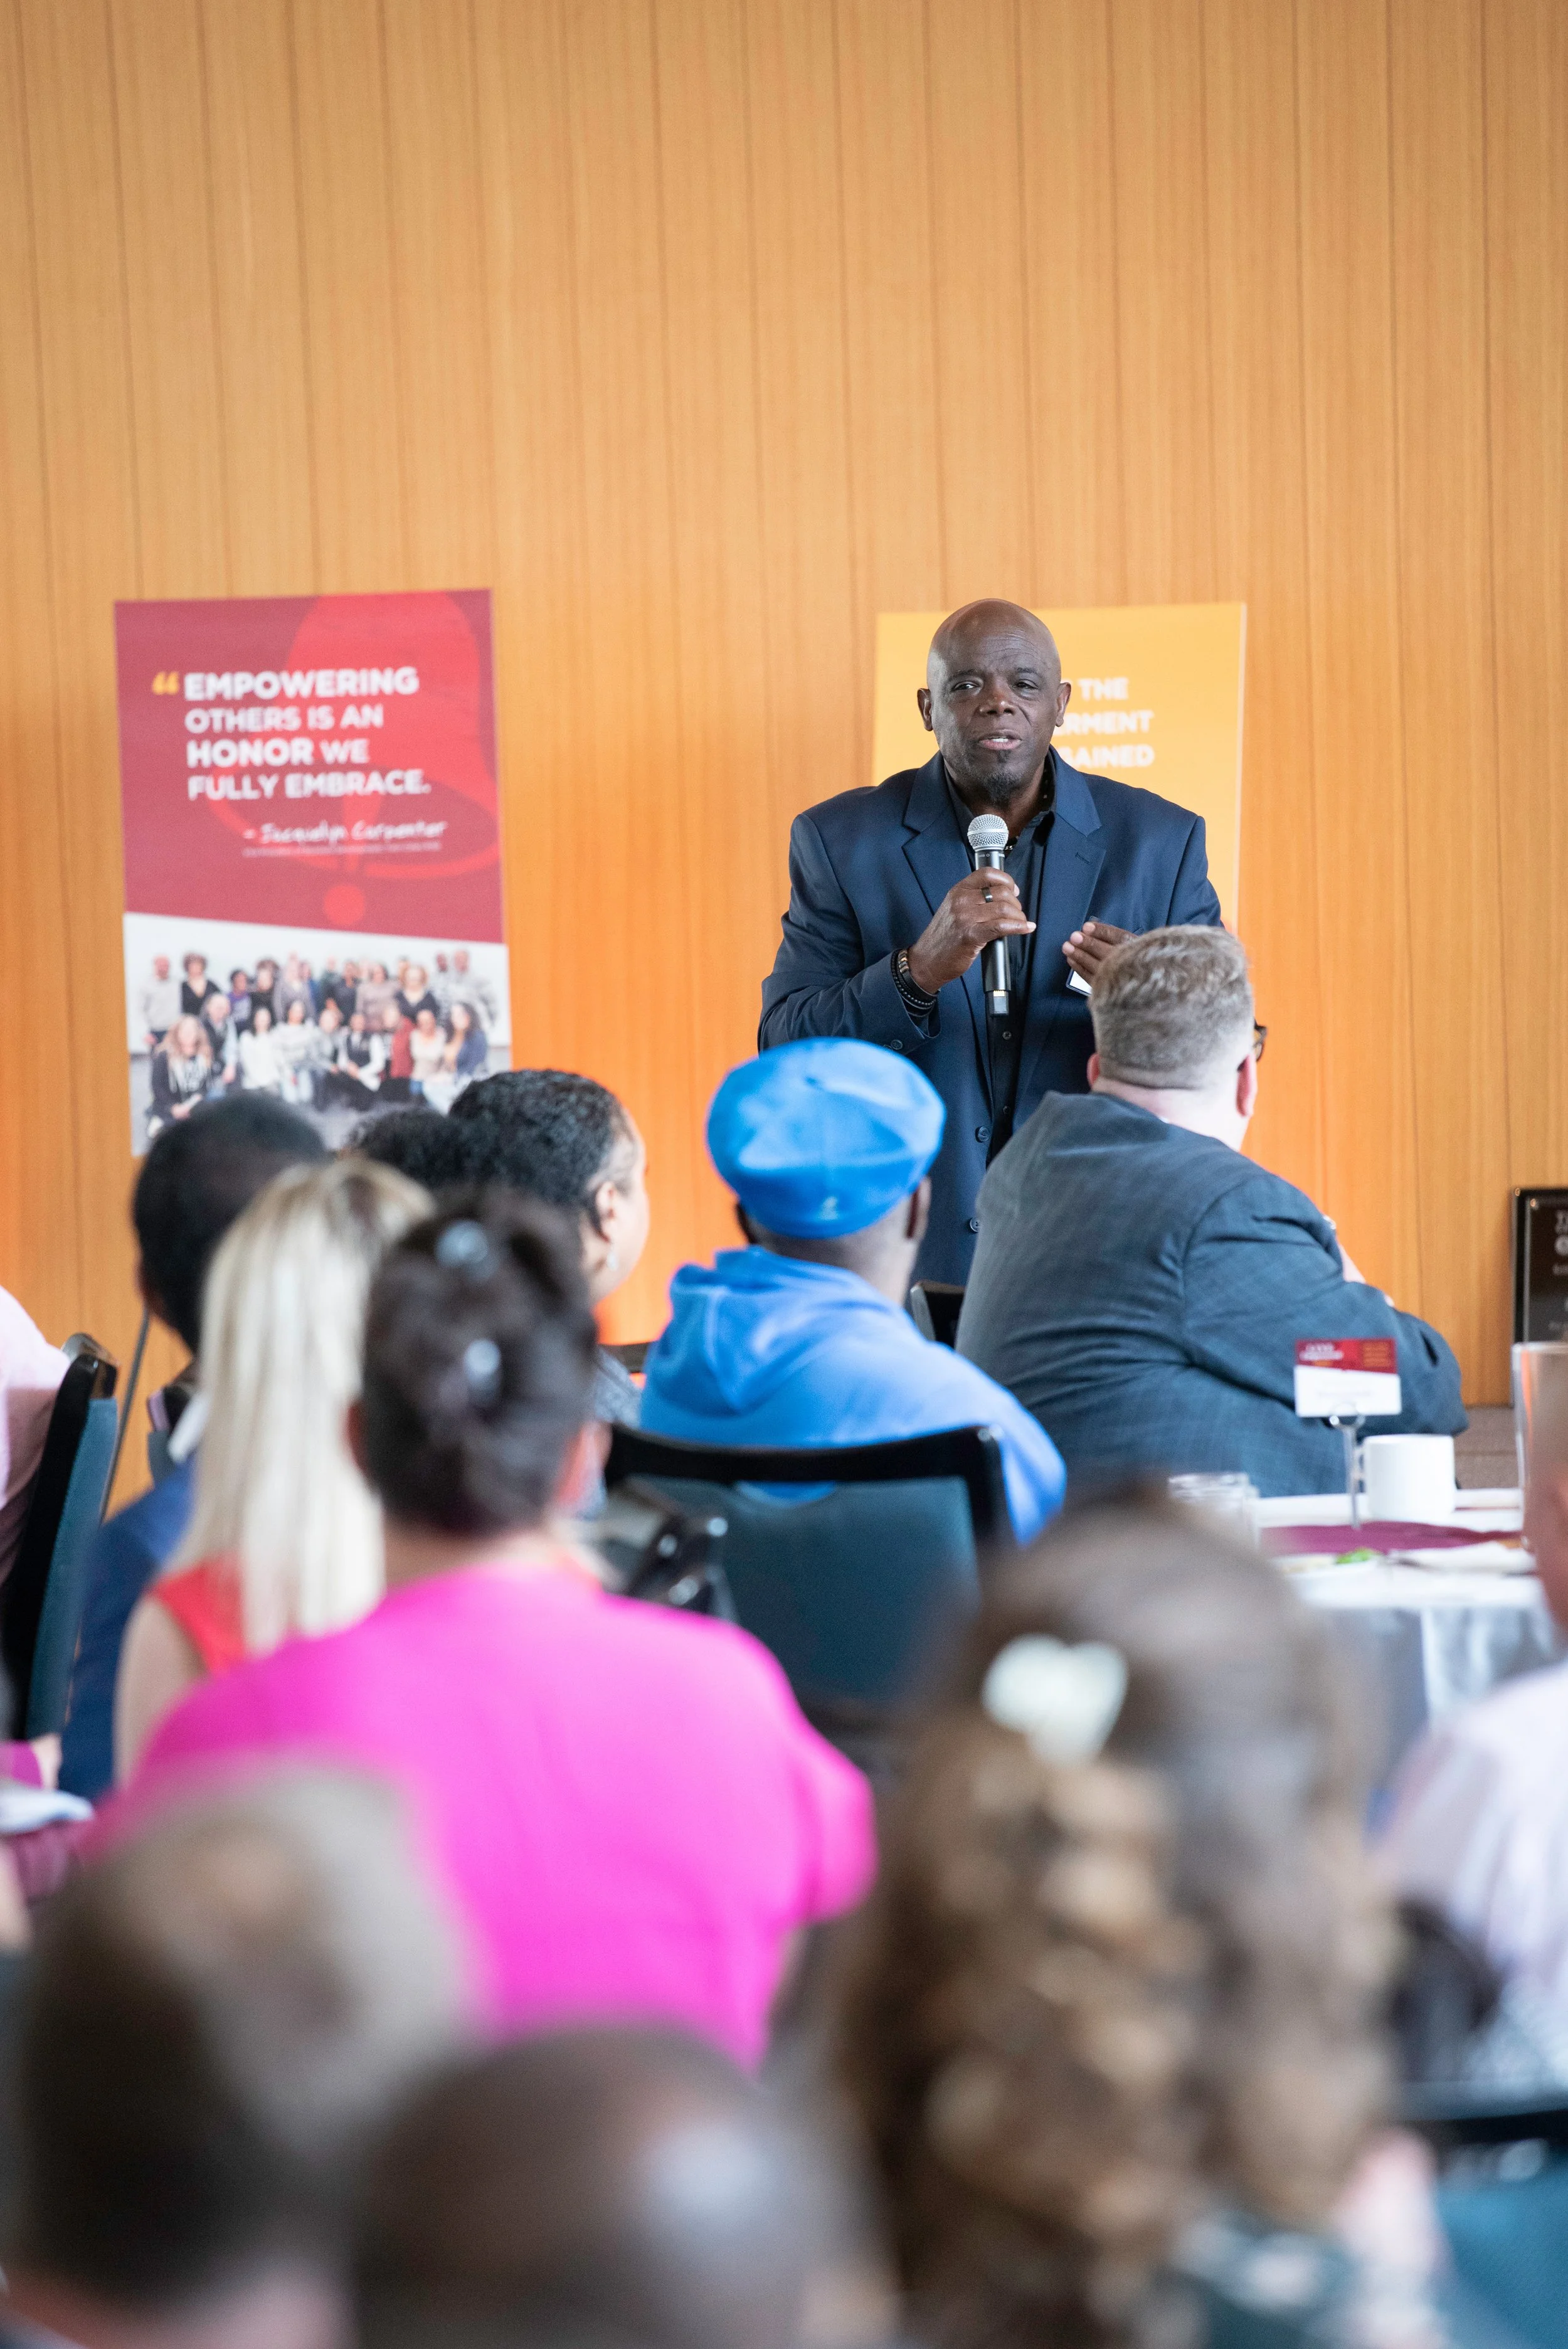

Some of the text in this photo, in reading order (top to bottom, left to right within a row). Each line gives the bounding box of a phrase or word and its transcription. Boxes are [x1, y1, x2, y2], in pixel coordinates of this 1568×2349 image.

[1079, 677, 1128, 701] THE
[184, 704, 384, 734] OTHERS IS AN
[186, 737, 369, 768] HONOR WE
[188, 768, 432, 801] FULLY EMBRACE.
